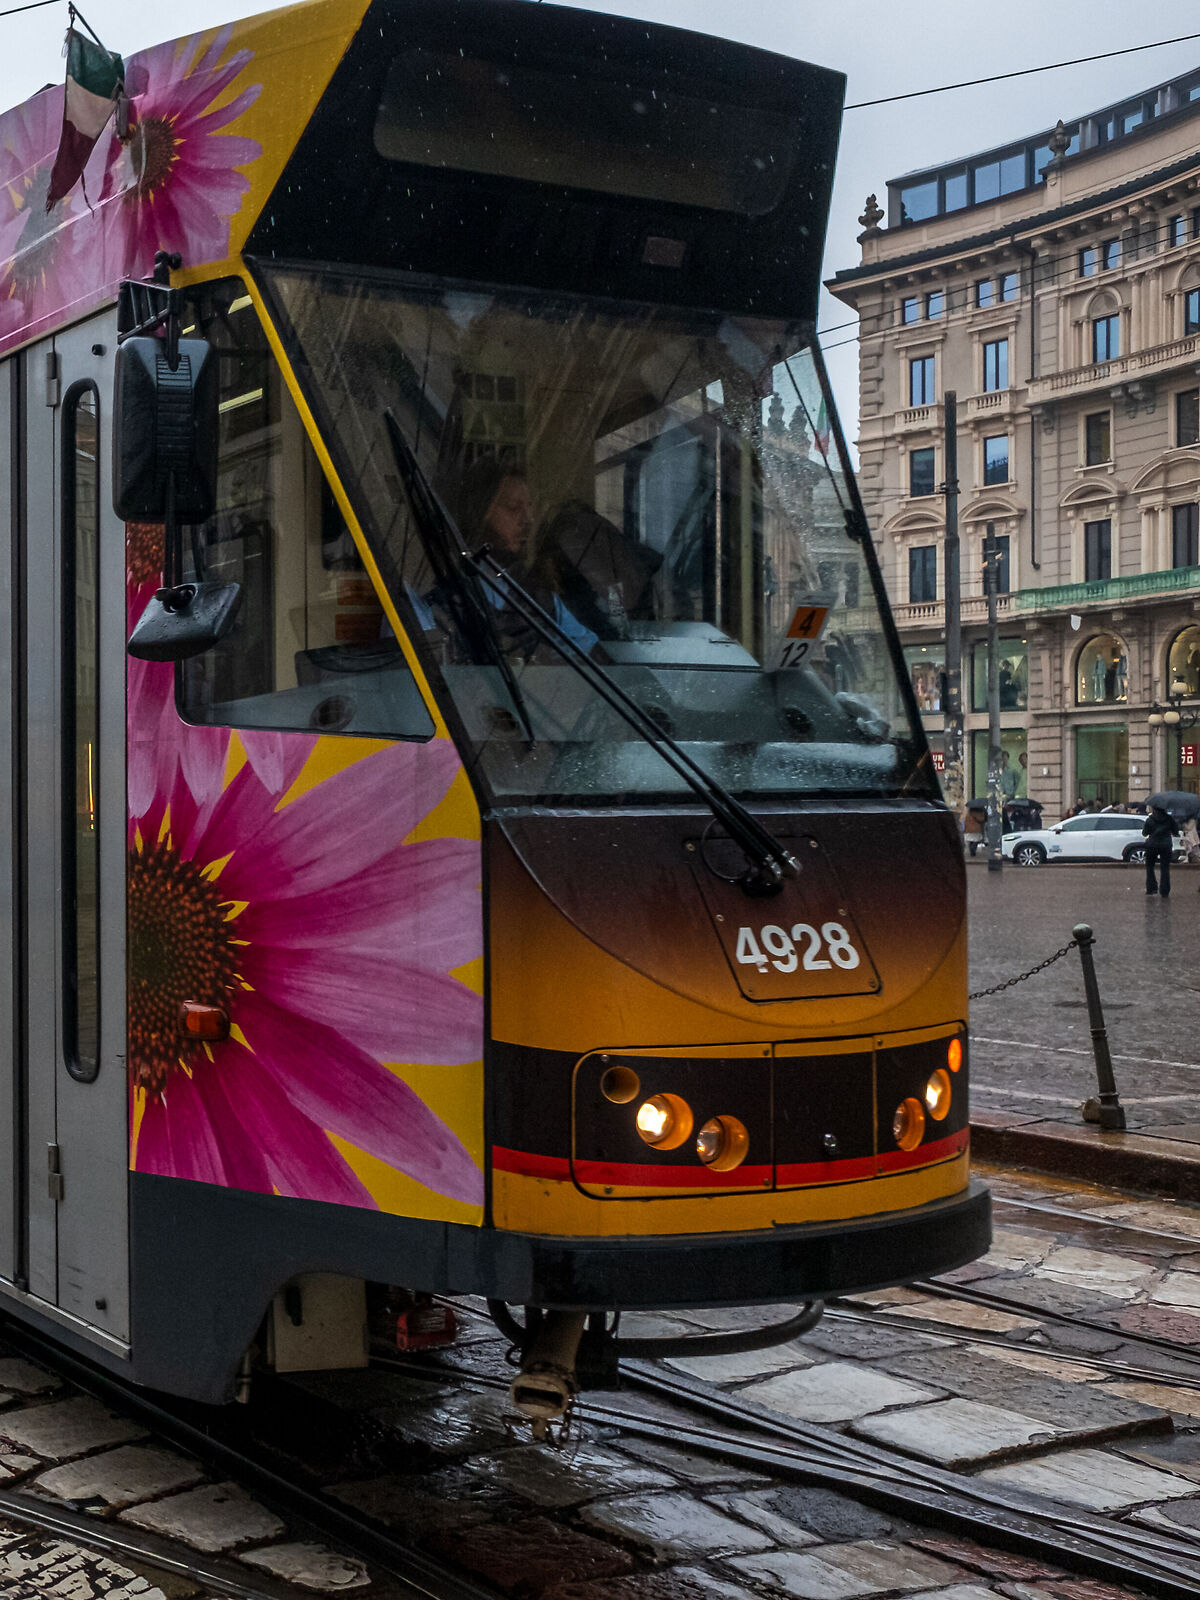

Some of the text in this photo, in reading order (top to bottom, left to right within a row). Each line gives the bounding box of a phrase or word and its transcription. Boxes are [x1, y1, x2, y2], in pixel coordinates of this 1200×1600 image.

[798, 609, 817, 636] 4
[780, 642, 808, 667] 12
[736, 922, 860, 973] 4928
